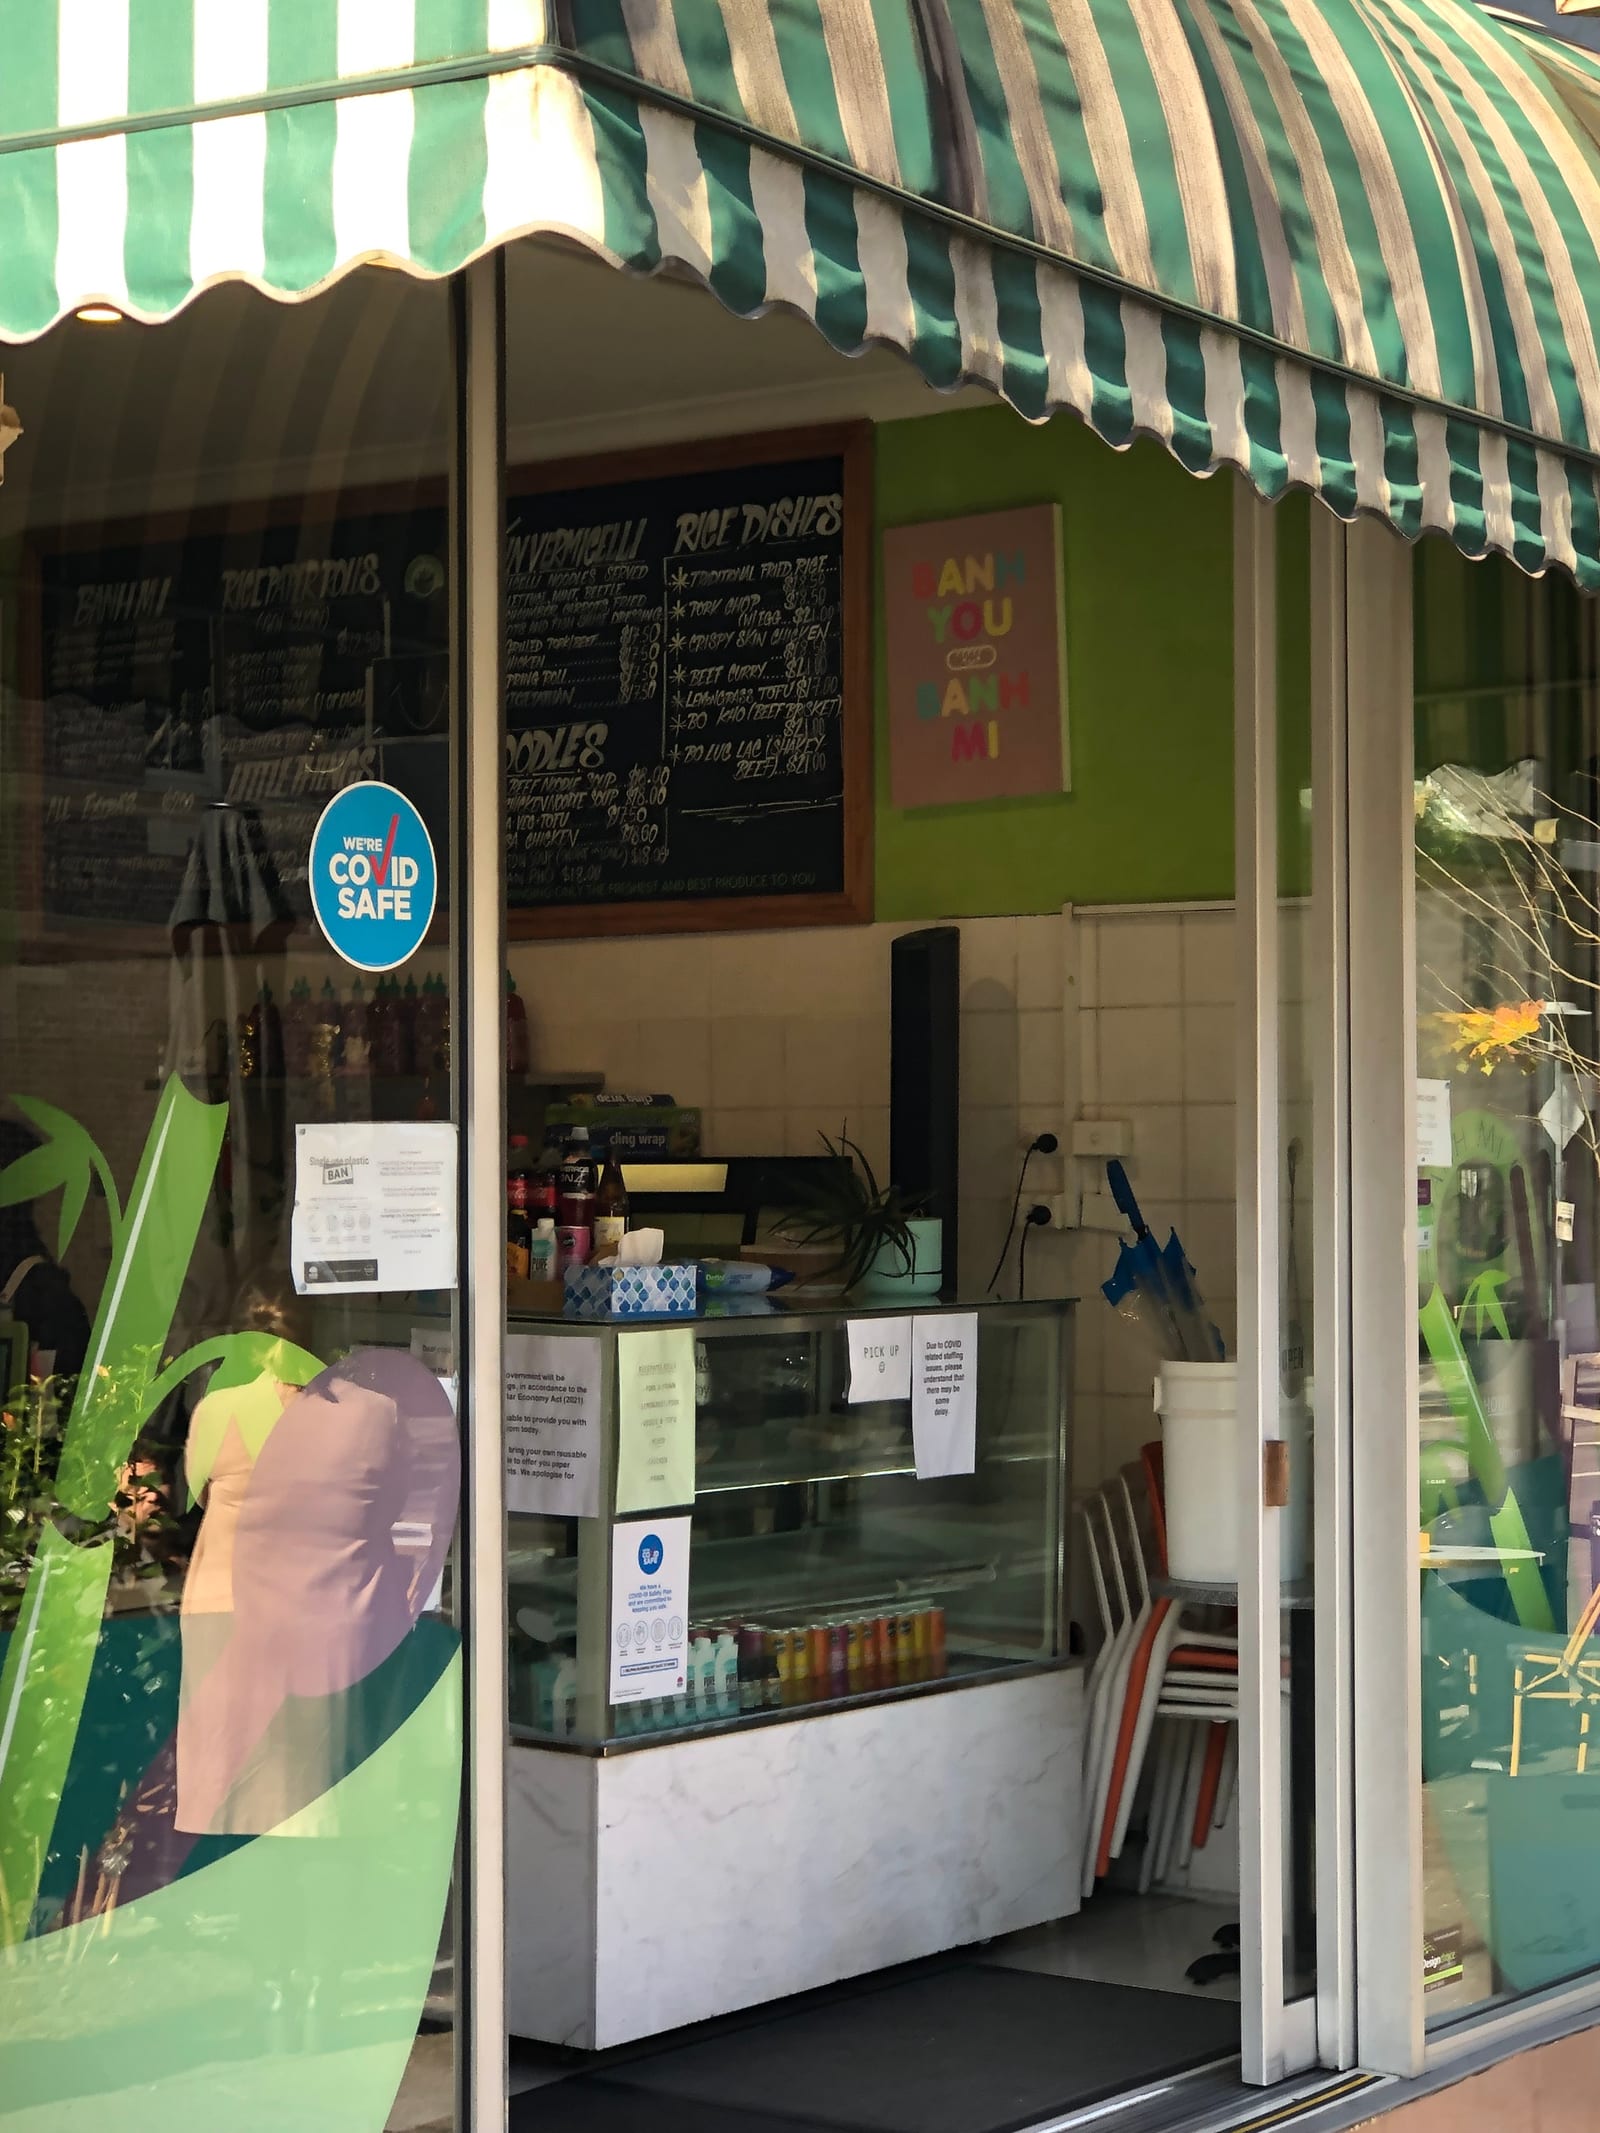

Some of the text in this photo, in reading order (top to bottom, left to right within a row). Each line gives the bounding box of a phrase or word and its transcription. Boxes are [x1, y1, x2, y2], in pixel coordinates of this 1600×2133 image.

[674, 493, 842, 553] RICE DISHES
[527, 517, 648, 572] VERMICELLI
[548, 565, 649, 587] NOODLES SERVED
[913, 550, 1025, 598] BANH
[613, 594, 647, 608] FRIED
[927, 597, 1012, 643] YOU
[689, 631, 735, 652] CRISPY
[737, 628, 767, 649] SKIN
[690, 665, 724, 686] BEEF
[728, 661, 767, 683] CURRY
[758, 683, 794, 700] TOFU
[916, 671, 1029, 720] BANH
[688, 712, 707, 729] BO
[716, 706, 745, 726] KHO
[736, 738, 762, 759] LAC
[951, 720, 998, 763] MI
[587, 771, 617, 789] SOUP
[590, 788, 619, 807] SOUP
[343, 836, 383, 852] WE'RE
[525, 829, 580, 849] CHICKEN
[329, 852, 419, 888] COVID
[687, 876, 712, 891] BEST
[715, 873, 768, 889] PRODUCE
[768, 872, 788, 887] TO
[792, 871, 816, 886] YOU
[338, 887, 412, 921] SAFE
[609, 1131, 666, 1148] cling wrap
[327, 1167, 349, 1181] BAN
[864, 1345, 900, 1358] PICK UP
[926, 1341, 937, 1349] Due
[944, 1340, 962, 1348] COVID
[944, 1352, 964, 1361] staffing
[944, 1364, 962, 1372] please
[923, 1375, 952, 1383] understand
[528, 1384, 567, 1392] accordance
[941, 1386, 952, 1394] may
[518, 1393, 549, 1403] Economy
[550, 1395, 563, 1403] Act
[563, 1396, 584, 1405] (2021)
[532, 1416, 557, 1424] provide
[571, 1418, 587, 1426] with
[508, 1446, 525, 1456] bring
[526, 1447, 541, 1456] your
[542, 1449, 556, 1457] own
[538, 1460, 550, 1468] you
[551, 1461, 570, 1469] paper
[532, 1470, 563, 1479] apologise
[563, 1471, 575, 1479] for
